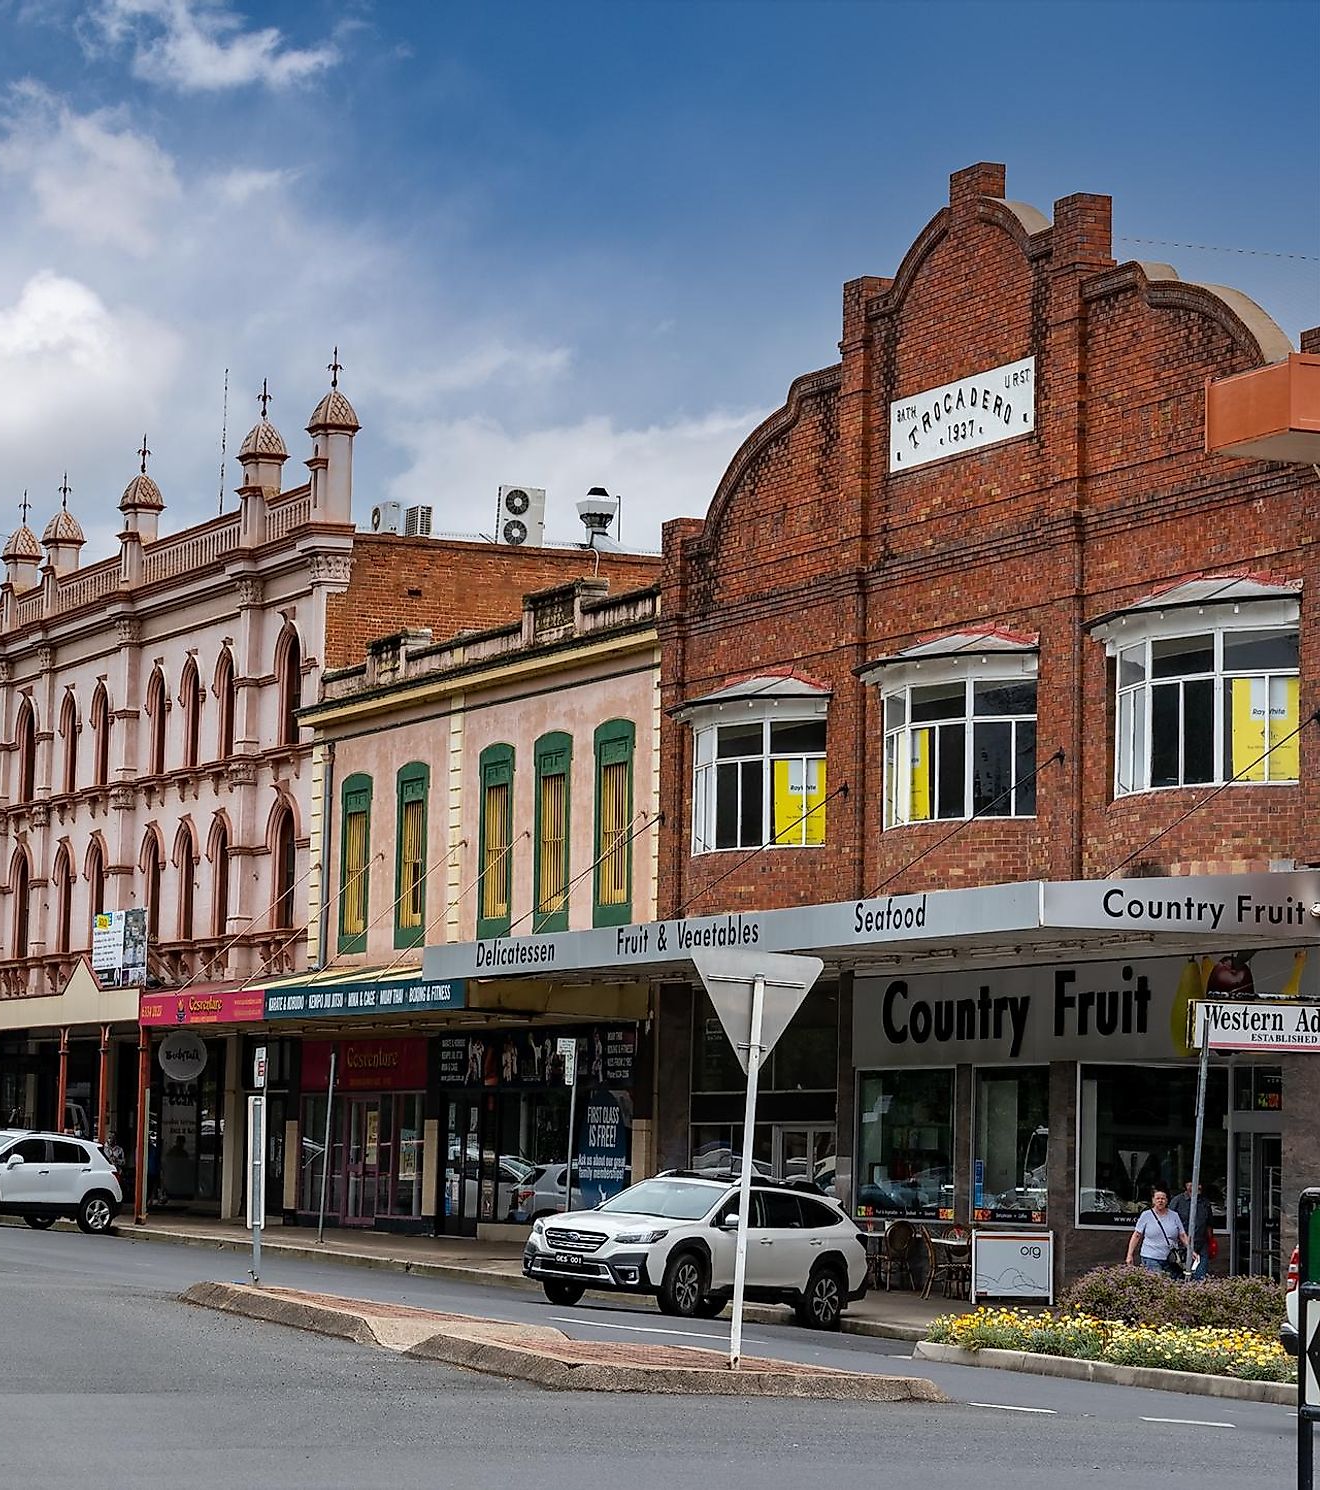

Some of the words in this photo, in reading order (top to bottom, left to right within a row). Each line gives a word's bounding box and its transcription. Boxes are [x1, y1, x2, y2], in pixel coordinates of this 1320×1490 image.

[907, 386, 1013, 450] TROCADERO
[947, 419, 976, 444] 1937
[854, 894, 928, 934] Seafood
[1103, 888, 1225, 930] Country
[1237, 894, 1306, 925] Fruit
[616, 926, 650, 956] Fruit
[657, 929, 669, 952] &
[475, 941, 557, 968] Delicatessen
[431, 984, 451, 1001] FITNESS
[882, 980, 1031, 1057] Country
[1053, 966, 1153, 1037] Fruit
[1204, 1004, 1284, 1032] Western
[1251, 1033, 1318, 1044] ESTABLISHED
[587, 1106, 602, 1124] FIRST
[603, 1106, 620, 1125] CLASS
[588, 1125, 596, 1147] IS
[597, 1125, 617, 1148] FREE!
[578, 1153, 586, 1165] Ask
[1020, 1246, 1042, 1259] org
